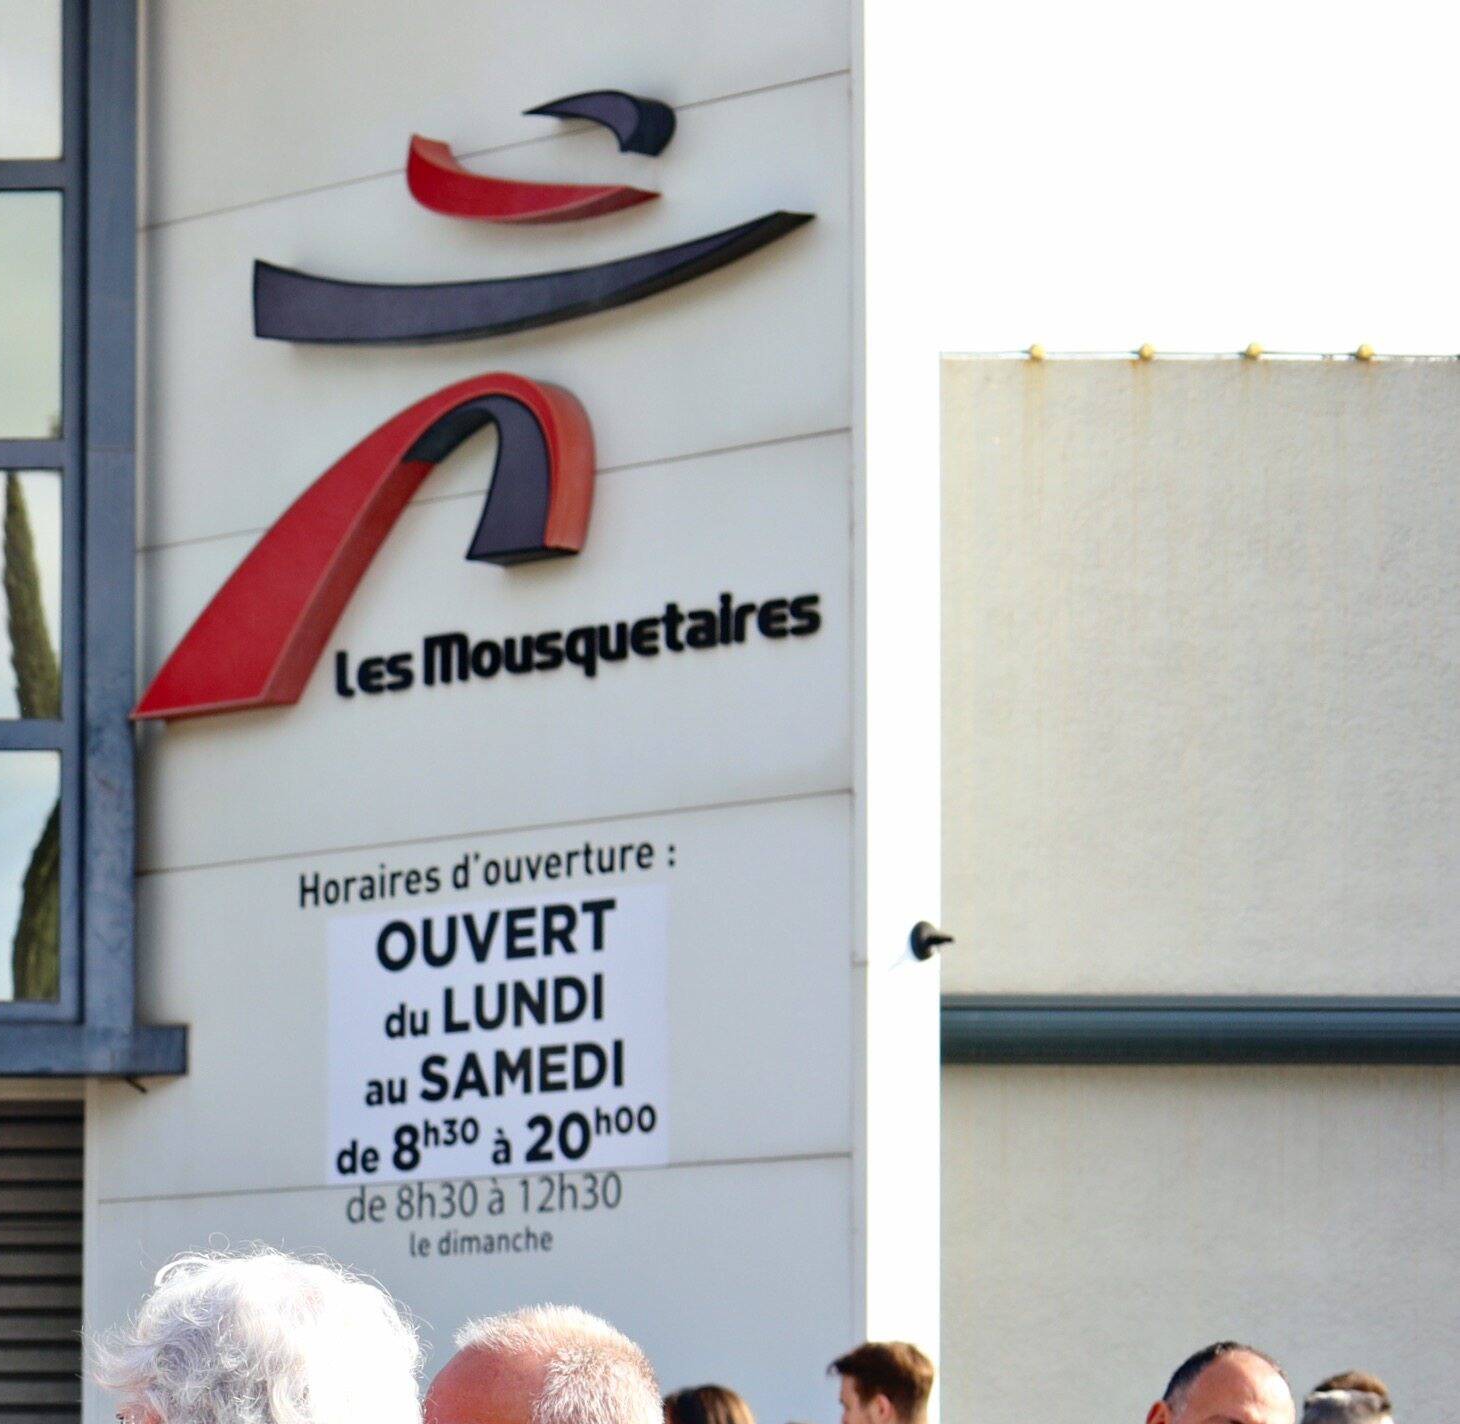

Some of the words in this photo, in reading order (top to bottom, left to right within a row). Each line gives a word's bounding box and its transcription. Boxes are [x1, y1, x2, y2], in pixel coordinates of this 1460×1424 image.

[424, 592, 822, 685] Mousquetaires
[299, 864, 441, 908] Horaires
[376, 898, 617, 973] OUVERT
[384, 1003, 430, 1040] du
[444, 973, 605, 1034] LUNDI
[365, 1076, 408, 1107] au
[420, 1039, 625, 1102] SAMEDI
[336, 1139, 380, 1176] de
[392, 1117, 480, 1172] 8h30
[492, 1129, 512, 1166] à
[526, 1104, 658, 1162] 20h00
[345, 1186, 387, 1225] de
[396, 1180, 478, 1222] 8h30
[487, 1176, 506, 1217] à
[520, 1171, 623, 1214] 12h30
[410, 1231, 431, 1258] le
[438, 1227, 554, 1257] dimanche
